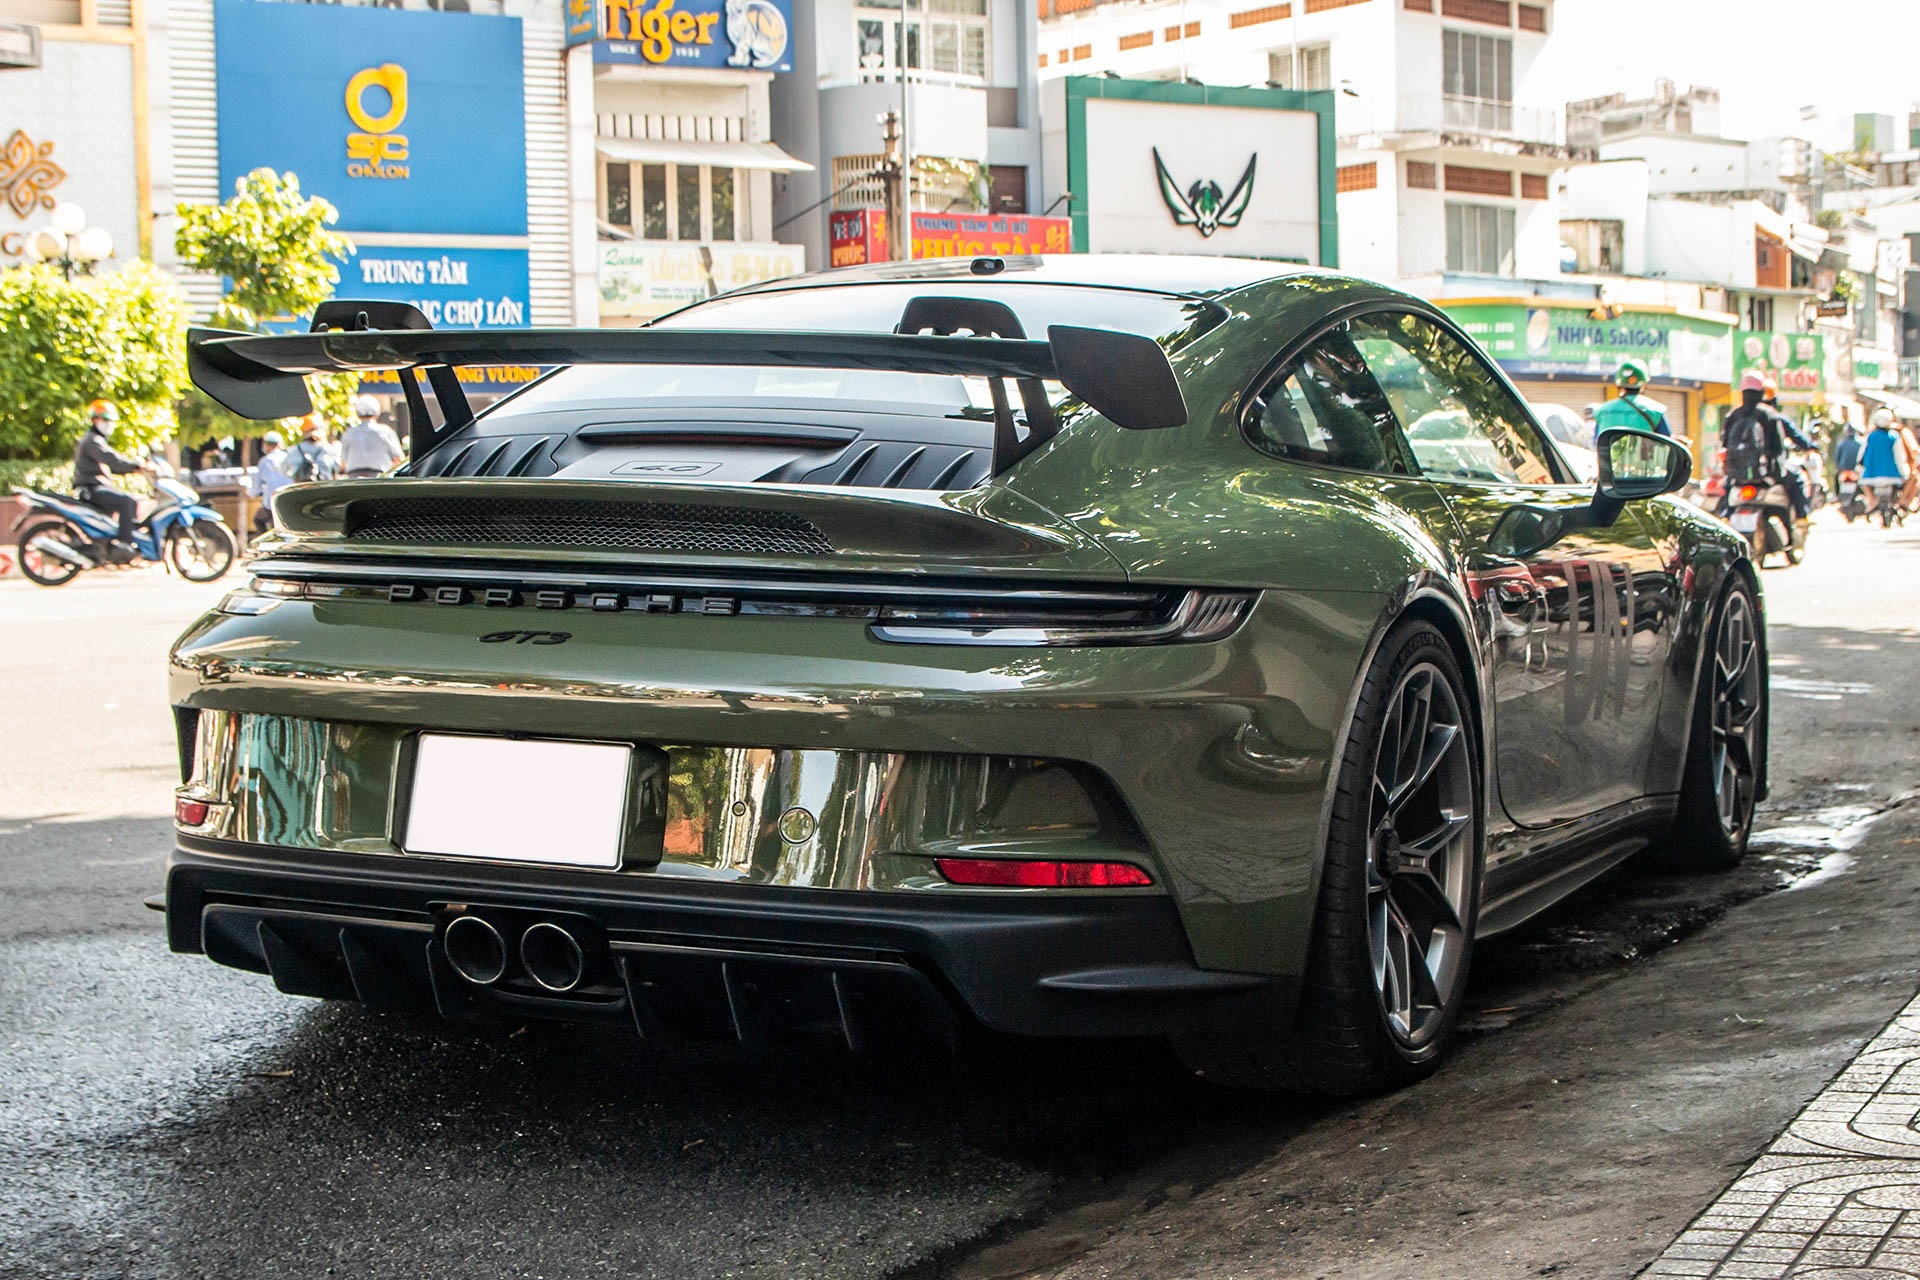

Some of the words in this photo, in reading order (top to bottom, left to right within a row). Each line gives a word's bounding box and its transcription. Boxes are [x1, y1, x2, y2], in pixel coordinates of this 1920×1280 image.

[605, 0, 719, 63] Tiger
[915, 217, 957, 231] TRUNG
[961, 218, 988, 232] TÂM
[360, 258, 425, 285] TRUNG
[427, 255, 468, 286] TÂM
[443, 297, 484, 329] CHỢ
[387, 583, 742, 616] PORSCHE
[477, 629, 572, 645] GT3
